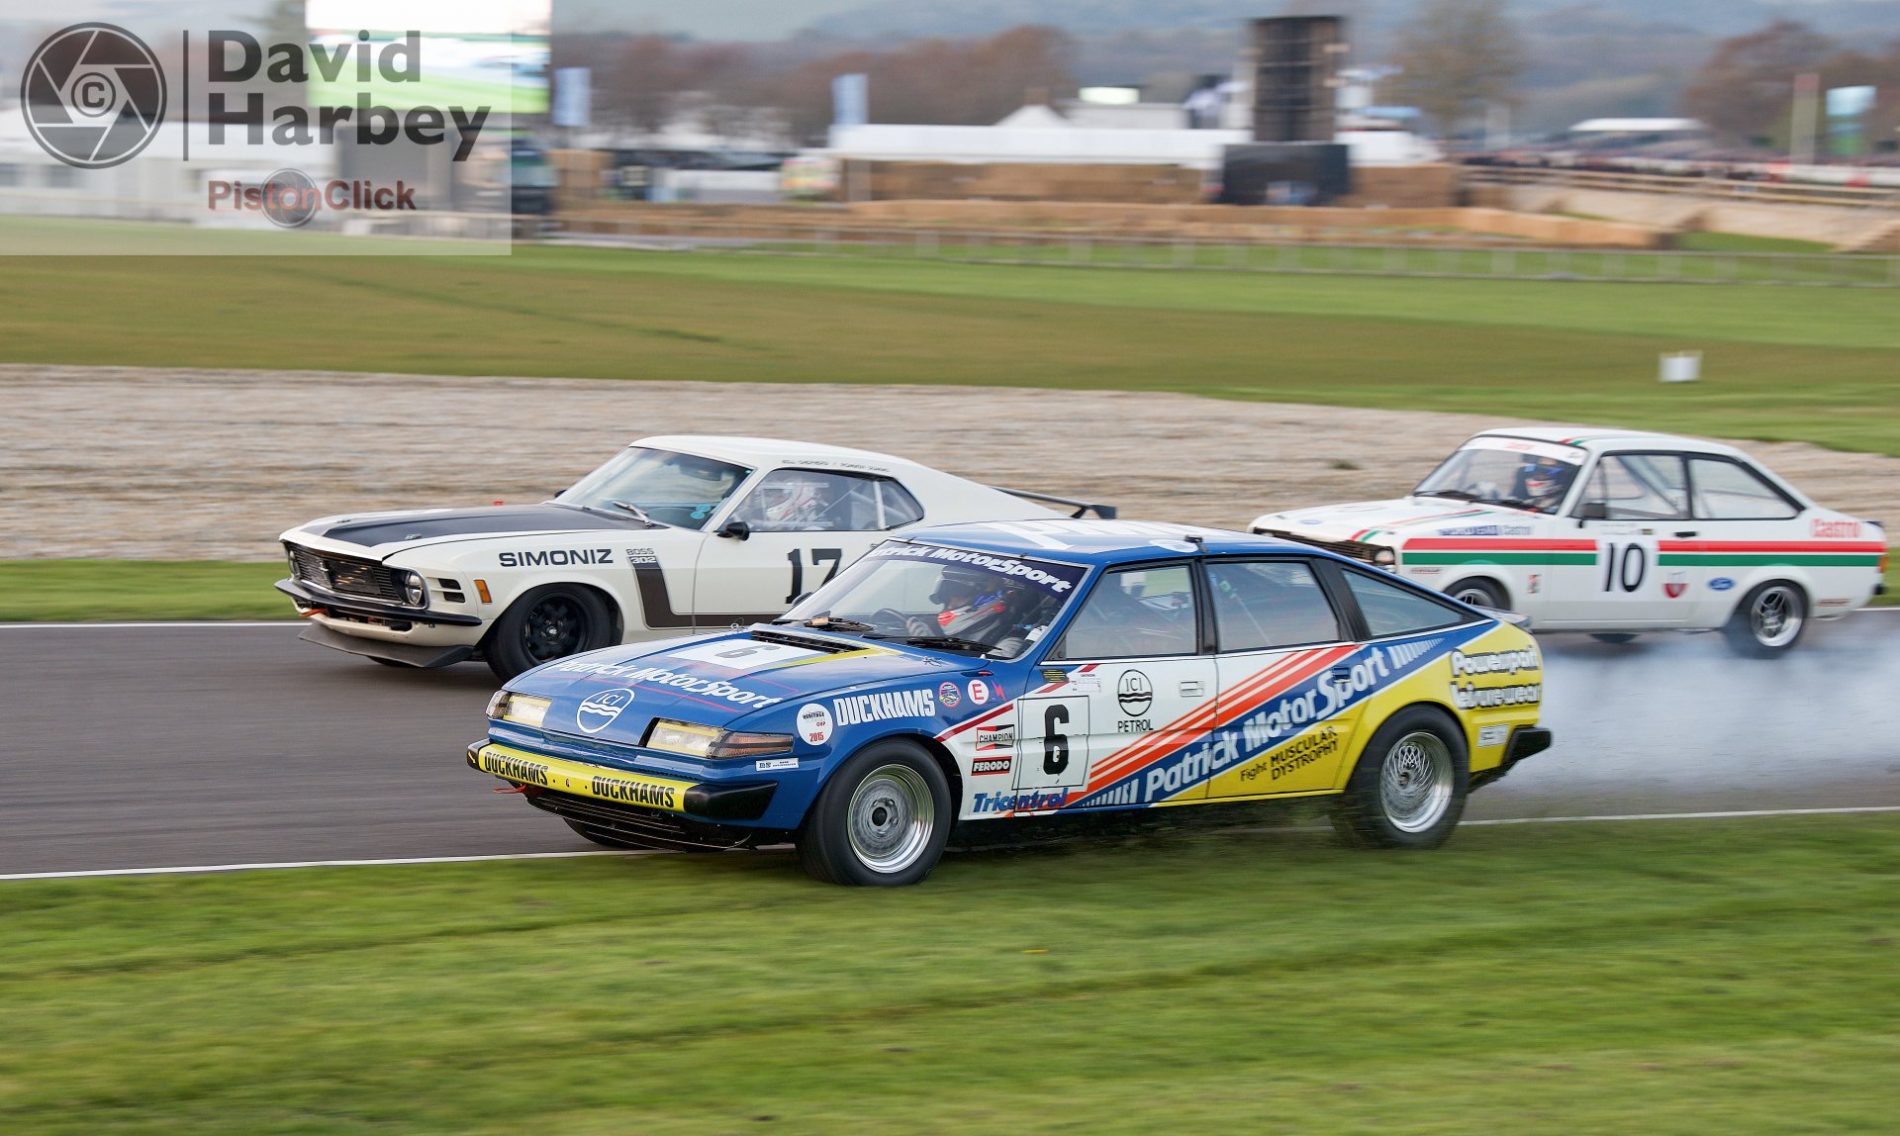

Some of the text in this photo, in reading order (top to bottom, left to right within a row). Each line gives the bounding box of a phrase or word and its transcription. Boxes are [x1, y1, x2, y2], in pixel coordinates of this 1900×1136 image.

[499, 549, 613, 567] SIMONIZ
[929, 549, 1073, 593] MotorSport
[1603, 542, 1646, 592] 10
[785, 548, 842, 604] 17
[596, 692, 624, 706] ICI
[625, 666, 783, 709] MotorSport
[972, 683, 984, 700] E
[1125, 678, 1142, 692] ICI
[832, 689, 936, 727] DUCKHAMS
[1144, 647, 1390, 802] Patrick MotorSport
[979, 732, 1013, 743] CHAMPION
[1043, 704, 1069, 774] 6
[1117, 719, 1153, 733] PETROL
[484, 751, 549, 786] DUCKHAMS
[974, 760, 1010, 772] FERODO
[1240, 726, 1337, 781] Fight MUSCULAR
[1271, 738, 1338, 781] DYSTROPHY
[592, 776, 675, 809] DUCKHAMS
[973, 787, 1069, 813] Tricentrol
